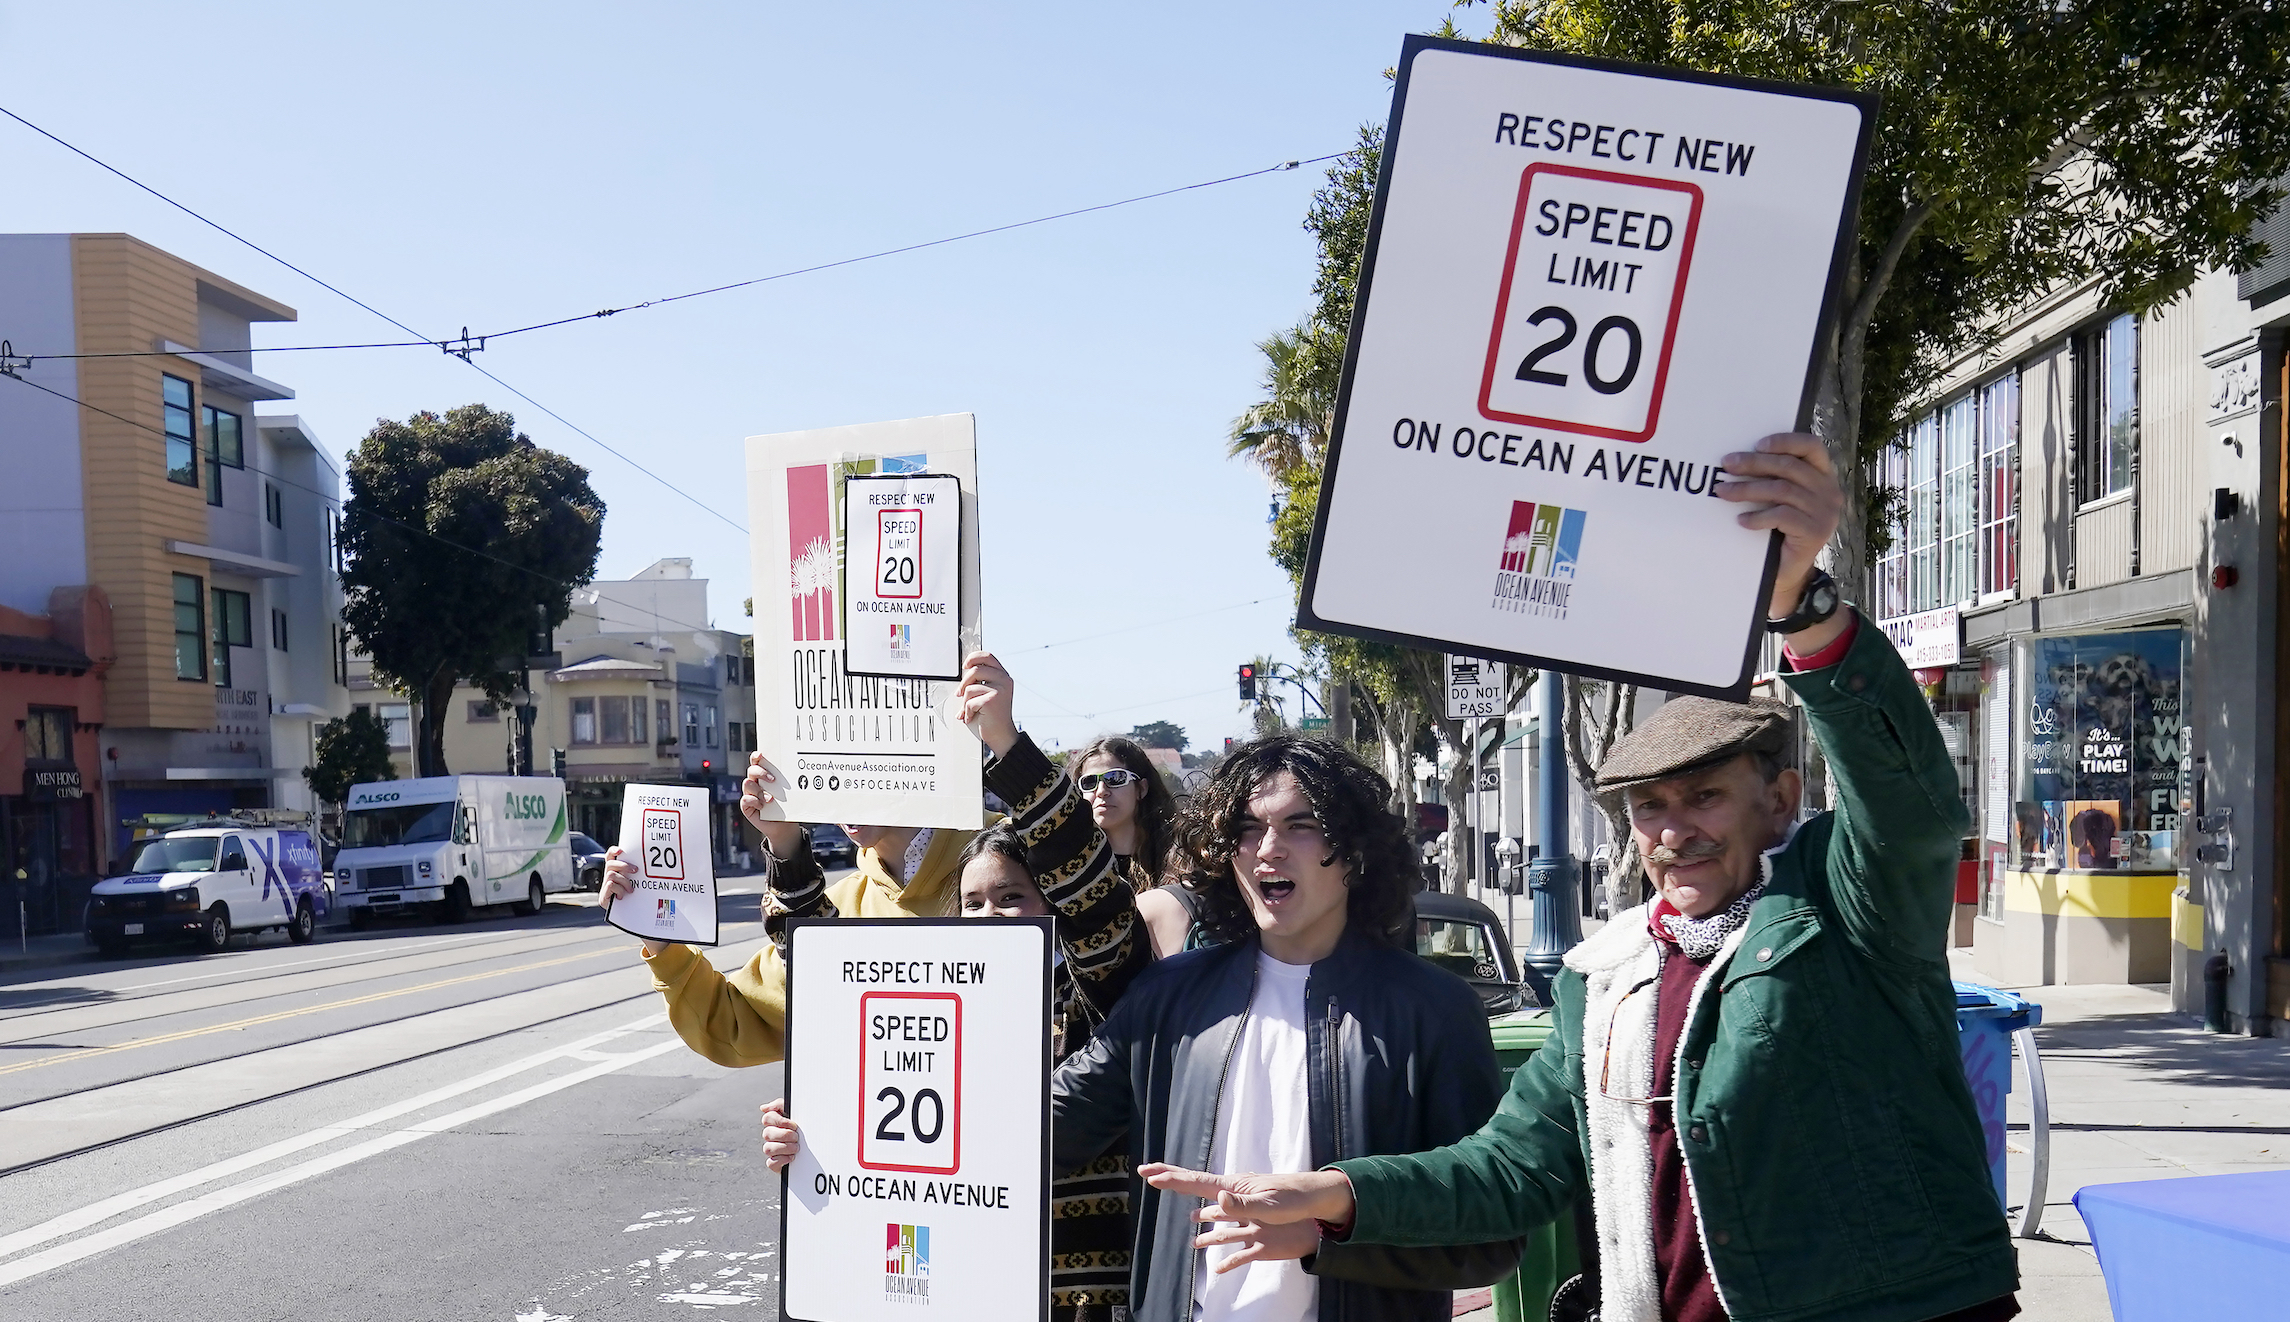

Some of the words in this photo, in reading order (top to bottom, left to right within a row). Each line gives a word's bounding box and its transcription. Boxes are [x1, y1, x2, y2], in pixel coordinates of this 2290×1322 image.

[1495, 113, 1665, 164] RESPECT
[1675, 137, 1754, 176] NEW
[1535, 199, 1673, 252] SPEED
[1548, 253, 1642, 293] LIMIT
[1515, 306, 1641, 394] 20
[1394, 418, 1441, 453] ON
[1453, 427, 1575, 474] OCEAN
[1583, 449, 1727, 498] AVENUE
[870, 494, 909, 505] RESPECT
[914, 494, 934, 504] NEW
[885, 521, 916, 533] SPEED
[889, 539, 909, 549] LIMIT
[884, 557, 914, 584] 20
[1494, 572, 1530, 601] OCEAN
[1529, 579, 1572, 608] AVENUE
[857, 601, 868, 612] ON
[872, 602, 902, 612] OCEAN
[907, 603, 945, 614] AVENUE
[1915, 612, 1939, 632] MARTIAL
[1940, 609, 1955, 627] ARTS
[1916, 643, 1955, 663] 415-333-1050
[794, 649, 854, 709] OCEAN
[235, 690, 257, 706] EAST
[1451, 687, 1468, 699] DO
[1476, 687, 1500, 698] NOT
[1460, 703, 1493, 714] PASS
[2152, 698, 2179, 711] This
[797, 715, 934, 742] ASSOCIATION
[2083, 744, 2124, 758] PLAY
[797, 758, 935, 775] OceanAvenueAssociation.org
[2080, 760, 2128, 774] TIME!
[2152, 769, 2175, 781] and
[35, 772, 55, 785] MEN
[56, 772, 80, 785] HONG
[844, 779, 935, 791] @SFOCEANAVE
[355, 793, 400, 804] ALSCO
[505, 791, 546, 820] ALSCO
[637, 796, 670, 806] RESPECT
[673, 799, 689, 807] NEW
[648, 818, 676, 829] SPEED
[652, 833, 670, 841] LIMIT
[286, 844, 315, 864] xfinity
[650, 847, 676, 868] 20
[642, 881, 669, 890] OCEAN
[673, 883, 704, 893] AVENUE
[844, 962, 933, 983] RESPECT
[943, 963, 985, 984] NEW
[873, 1015, 948, 1041] SPEED
[884, 1051, 934, 1072] LIMIT
[876, 1087, 943, 1143] 20
[815, 1173, 839, 1195] ON
[848, 1176, 915, 1201] OCEAN
[924, 1182, 1009, 1208] AVENUE
[886, 1275, 905, 1294] OCEAN
[906, 1277, 929, 1296] AVENUE
